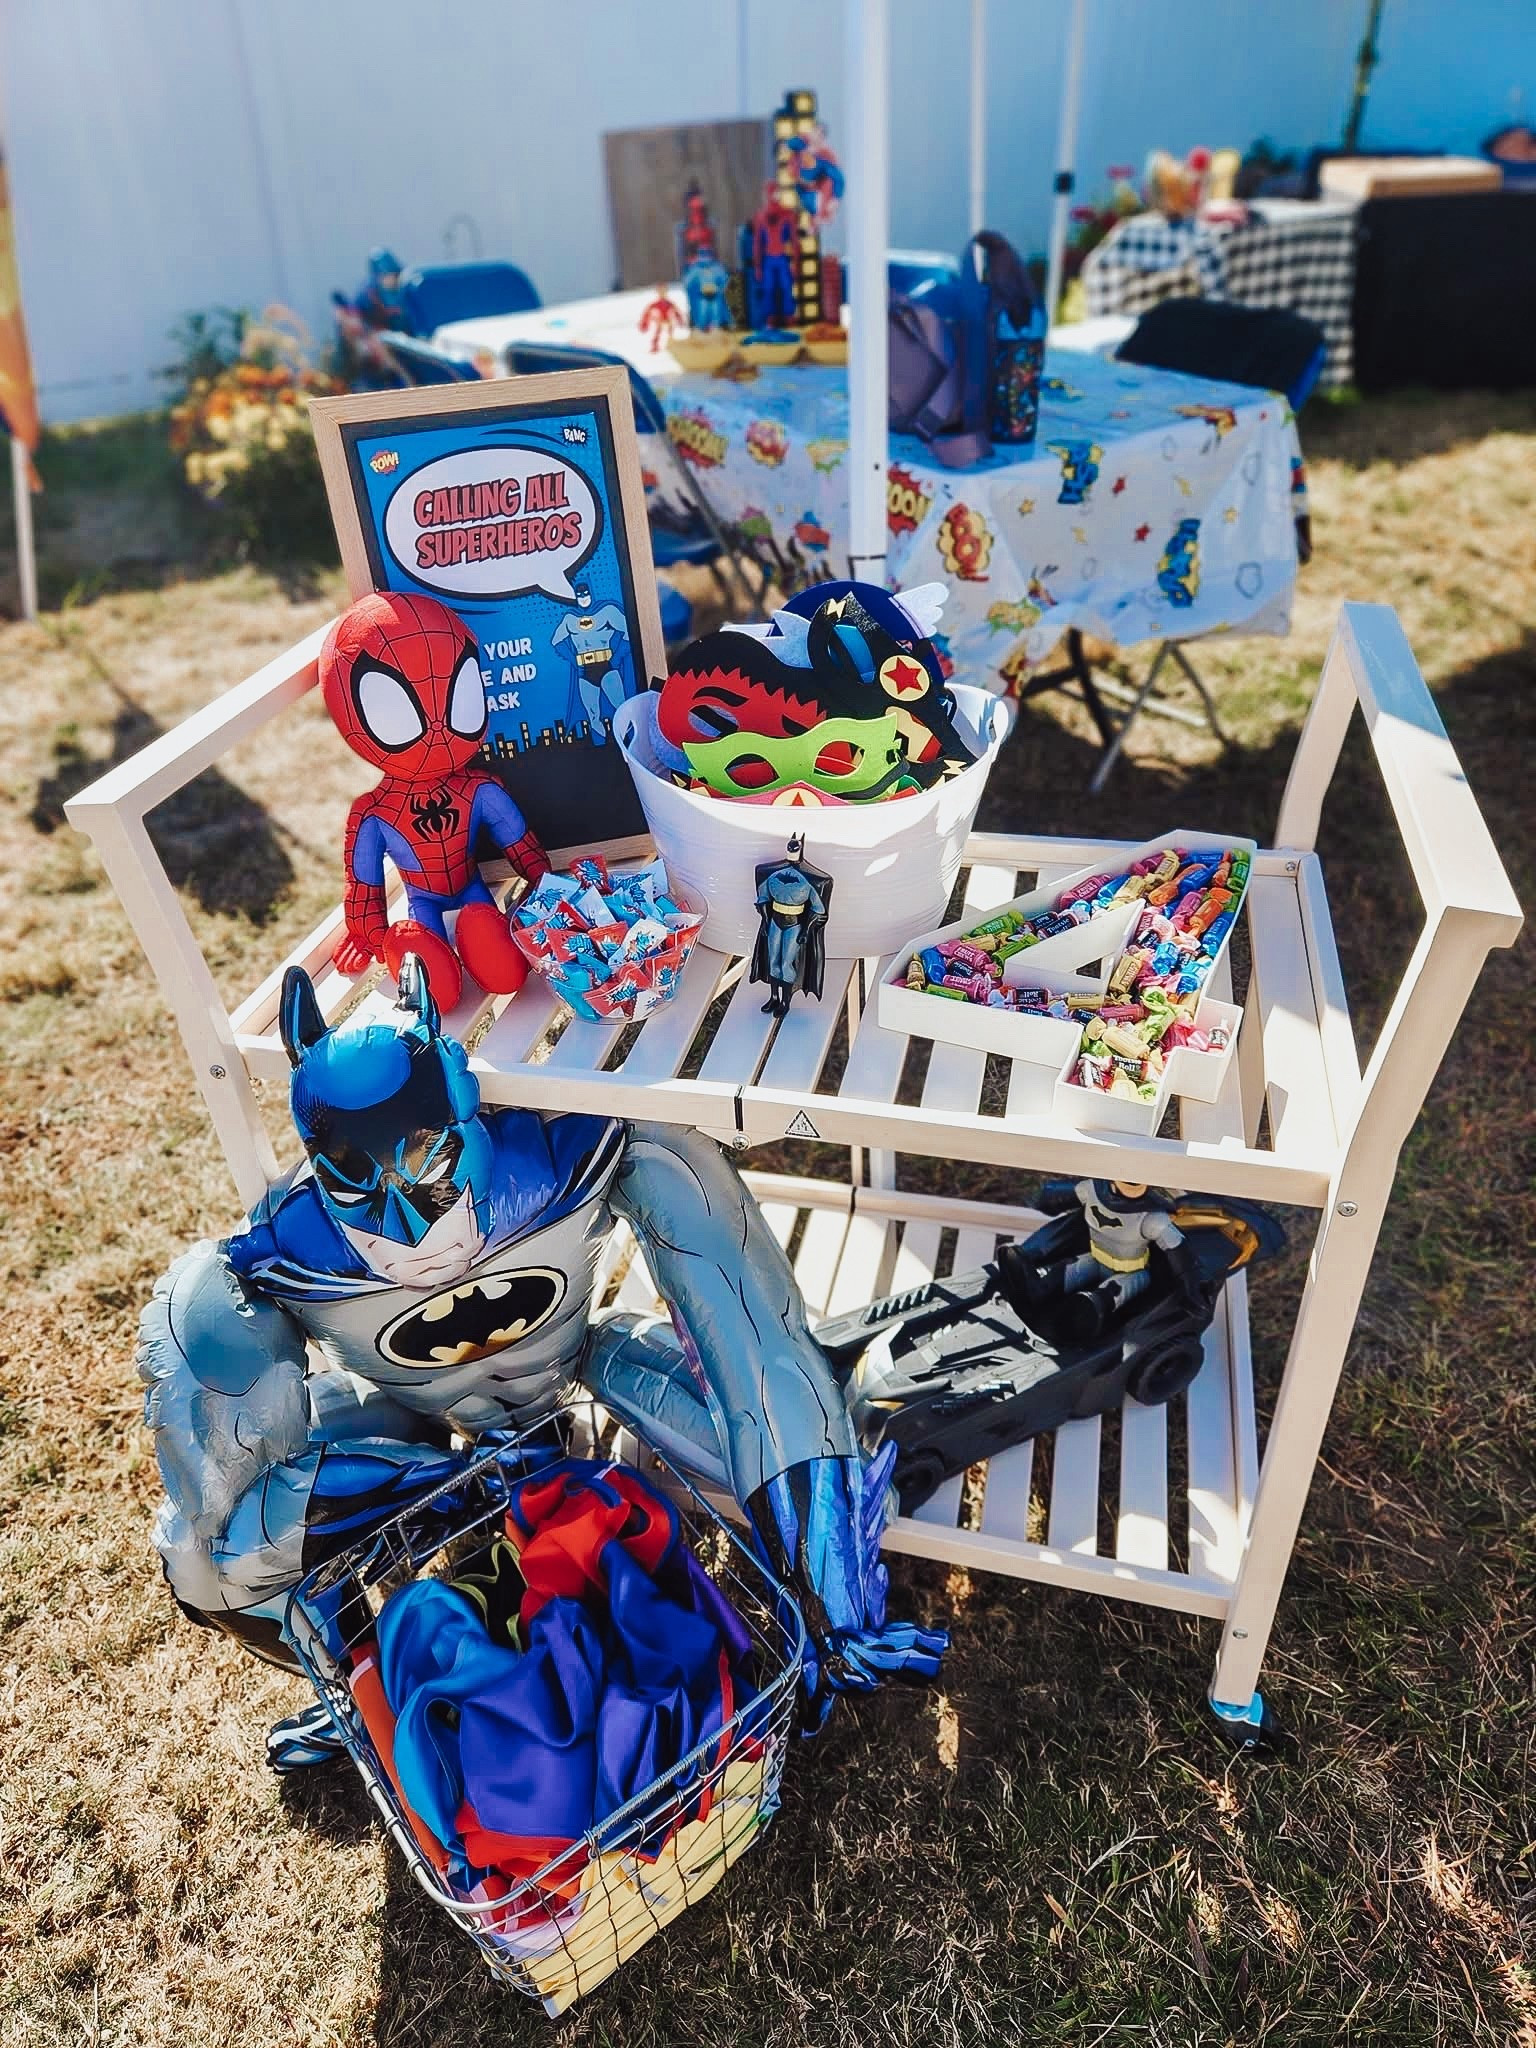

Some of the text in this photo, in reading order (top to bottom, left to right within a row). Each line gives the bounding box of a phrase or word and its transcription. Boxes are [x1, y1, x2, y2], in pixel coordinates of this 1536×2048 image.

[563, 428, 586, 443] BANG
[369, 451, 400, 474] POW!
[414, 471, 570, 529] CALLING ALL
[415, 512, 582, 569] SUPERHEROS
[484, 637, 533, 661] YOUR
[501, 663, 537, 685] AND
[487, 691, 521, 713] ASK
[1119, 1062, 1135, 1071] Roll
